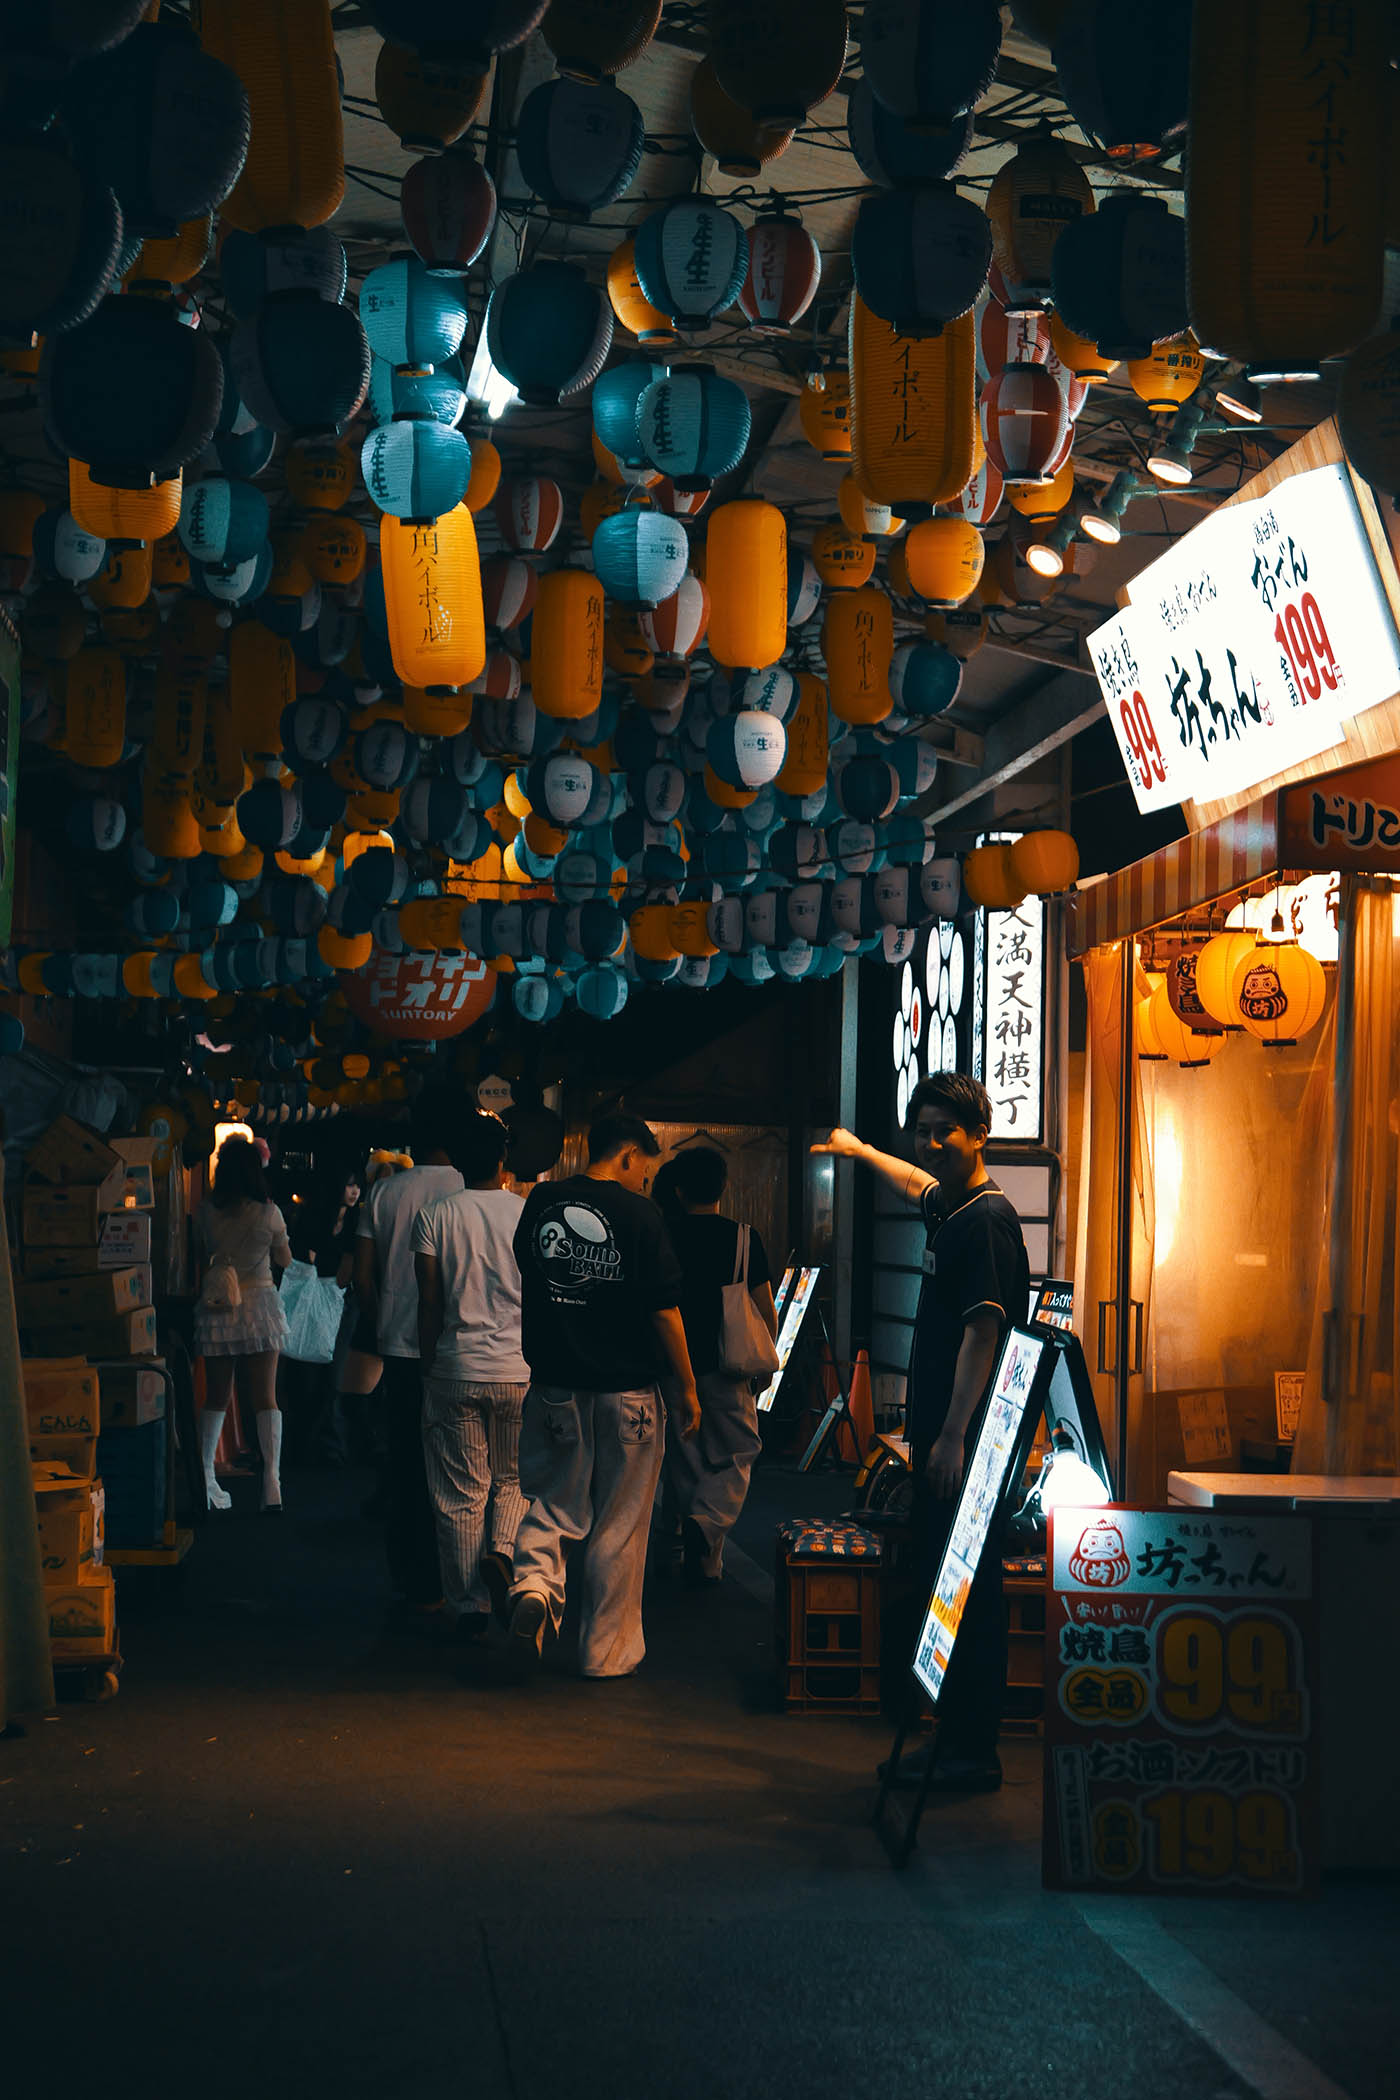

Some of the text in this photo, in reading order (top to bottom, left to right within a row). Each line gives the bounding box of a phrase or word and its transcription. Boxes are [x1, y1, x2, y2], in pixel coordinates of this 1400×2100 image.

[1251, 535, 1309, 613] おでん
[1274, 591, 1338, 706] 199
[1119, 690, 1166, 791] 99
[555, 1238, 621, 1265] SOLID
[1136, 1538, 1286, 1587] 坊っちゃん
[1064, 1630, 1150, 1664] 焼鳥
[1162, 1616, 1289, 1724] 99
[1073, 1676, 1136, 1709] 全品
[1143, 1793, 1288, 1880] 199
